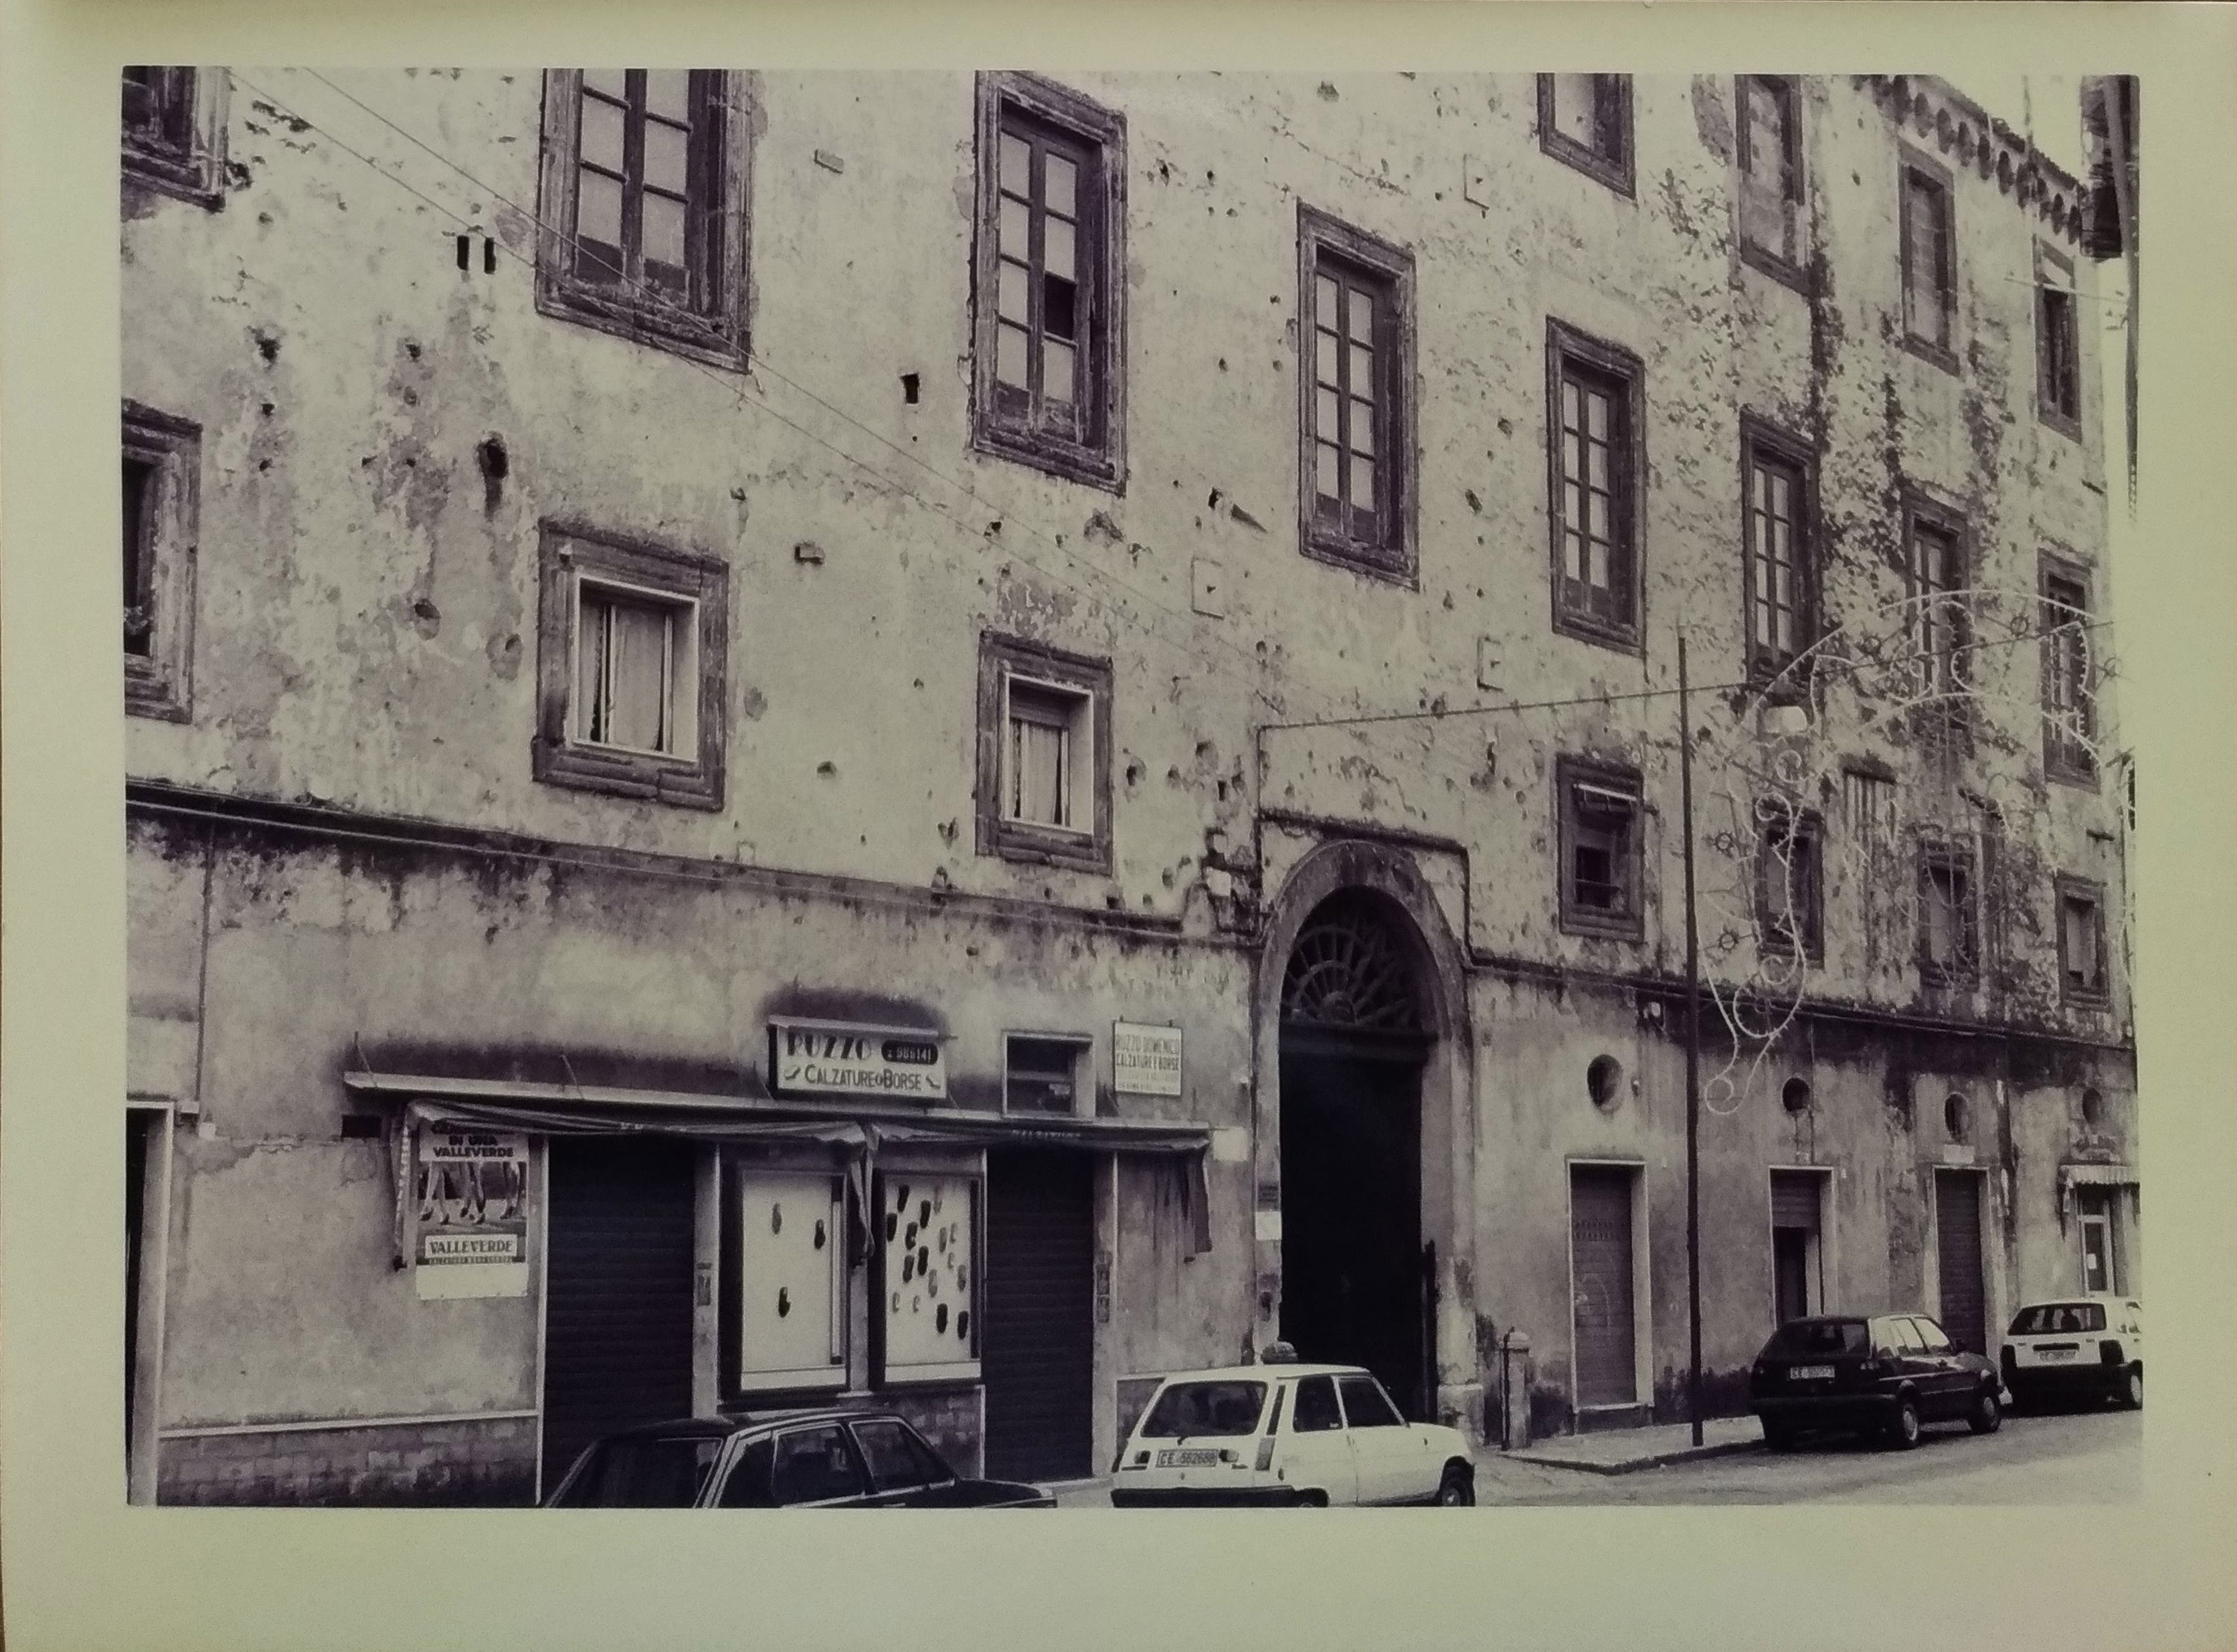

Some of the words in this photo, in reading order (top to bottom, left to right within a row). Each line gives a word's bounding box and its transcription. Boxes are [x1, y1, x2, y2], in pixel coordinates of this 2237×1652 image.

[788, 1034, 871, 1060] RUZZO
[804, 1063, 875, 1087] CALZATURE
[883, 1068, 921, 1091] BORSE
[449, 1135, 463, 1145] IN
[468, 1135, 498, 1146] UNA
[433, 1147, 514, 1158] VALLEVERDE
[429, 1240, 513, 1255] VALLEVERDE
[1160, 1452, 1174, 1465] CE
